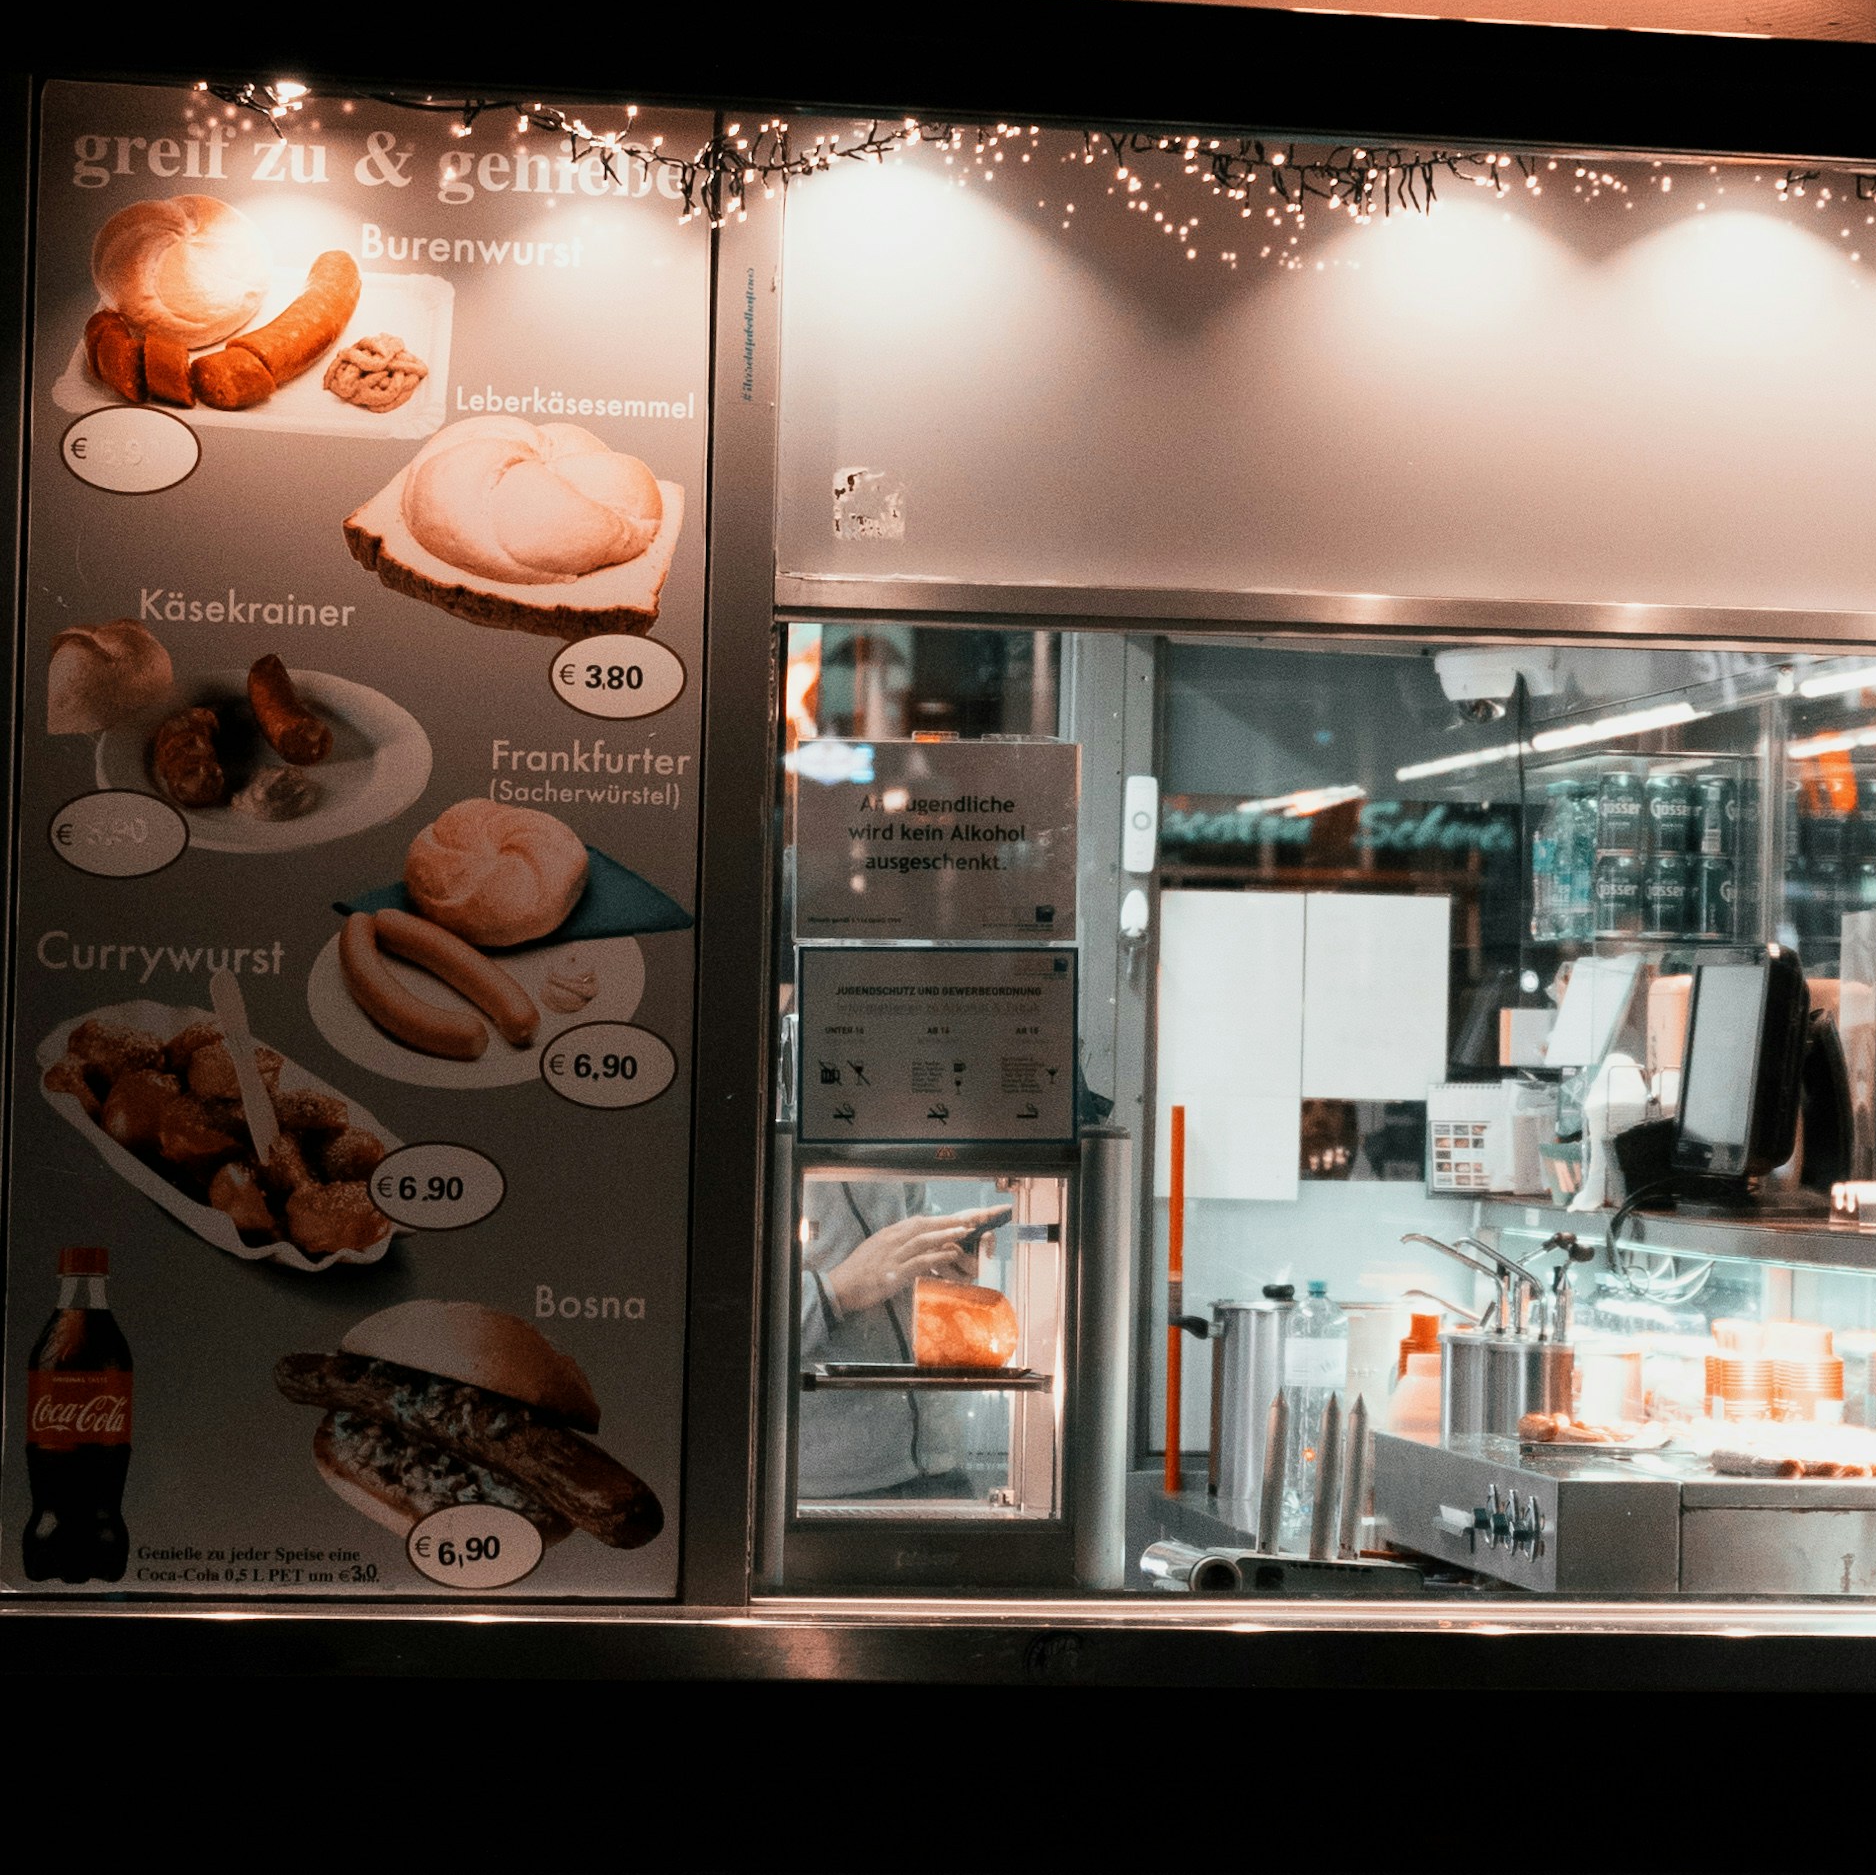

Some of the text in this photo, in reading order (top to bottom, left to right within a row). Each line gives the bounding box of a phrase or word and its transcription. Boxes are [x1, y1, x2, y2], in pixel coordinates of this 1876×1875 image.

[72, 124, 233, 188] greif
[252, 140, 330, 184] zu
[354, 130, 414, 188] &
[360, 223, 585, 268] Burenwurst
[455, 384, 696, 420] Leberkäsesemmel
[138, 587, 357, 628] Käsekrainer
[491, 739, 692, 777] Frankfurter
[488, 778, 682, 811] (Sacherwürstel)
[847, 824, 1027, 843] wird kein Alkohol
[865, 853, 1009, 874] ausgeschenkt.
[36, 930, 286, 983] Currywurst
[834, 985, 1043, 997] JUGENDSCHUTZ UND GEWERBEORDNUNG
[534, 1285, 647, 1321] Bosna
[31, 1394, 129, 1433] Coca-Cola
[136, 1546, 361, 1564] Genieße zu jeder Speise eine
[136, 1567, 220, 1582] Coca-Cola
[252, 1568, 265, 1582] L
[269, 1568, 304, 1583] PET
[308, 1572, 334, 1582] um
